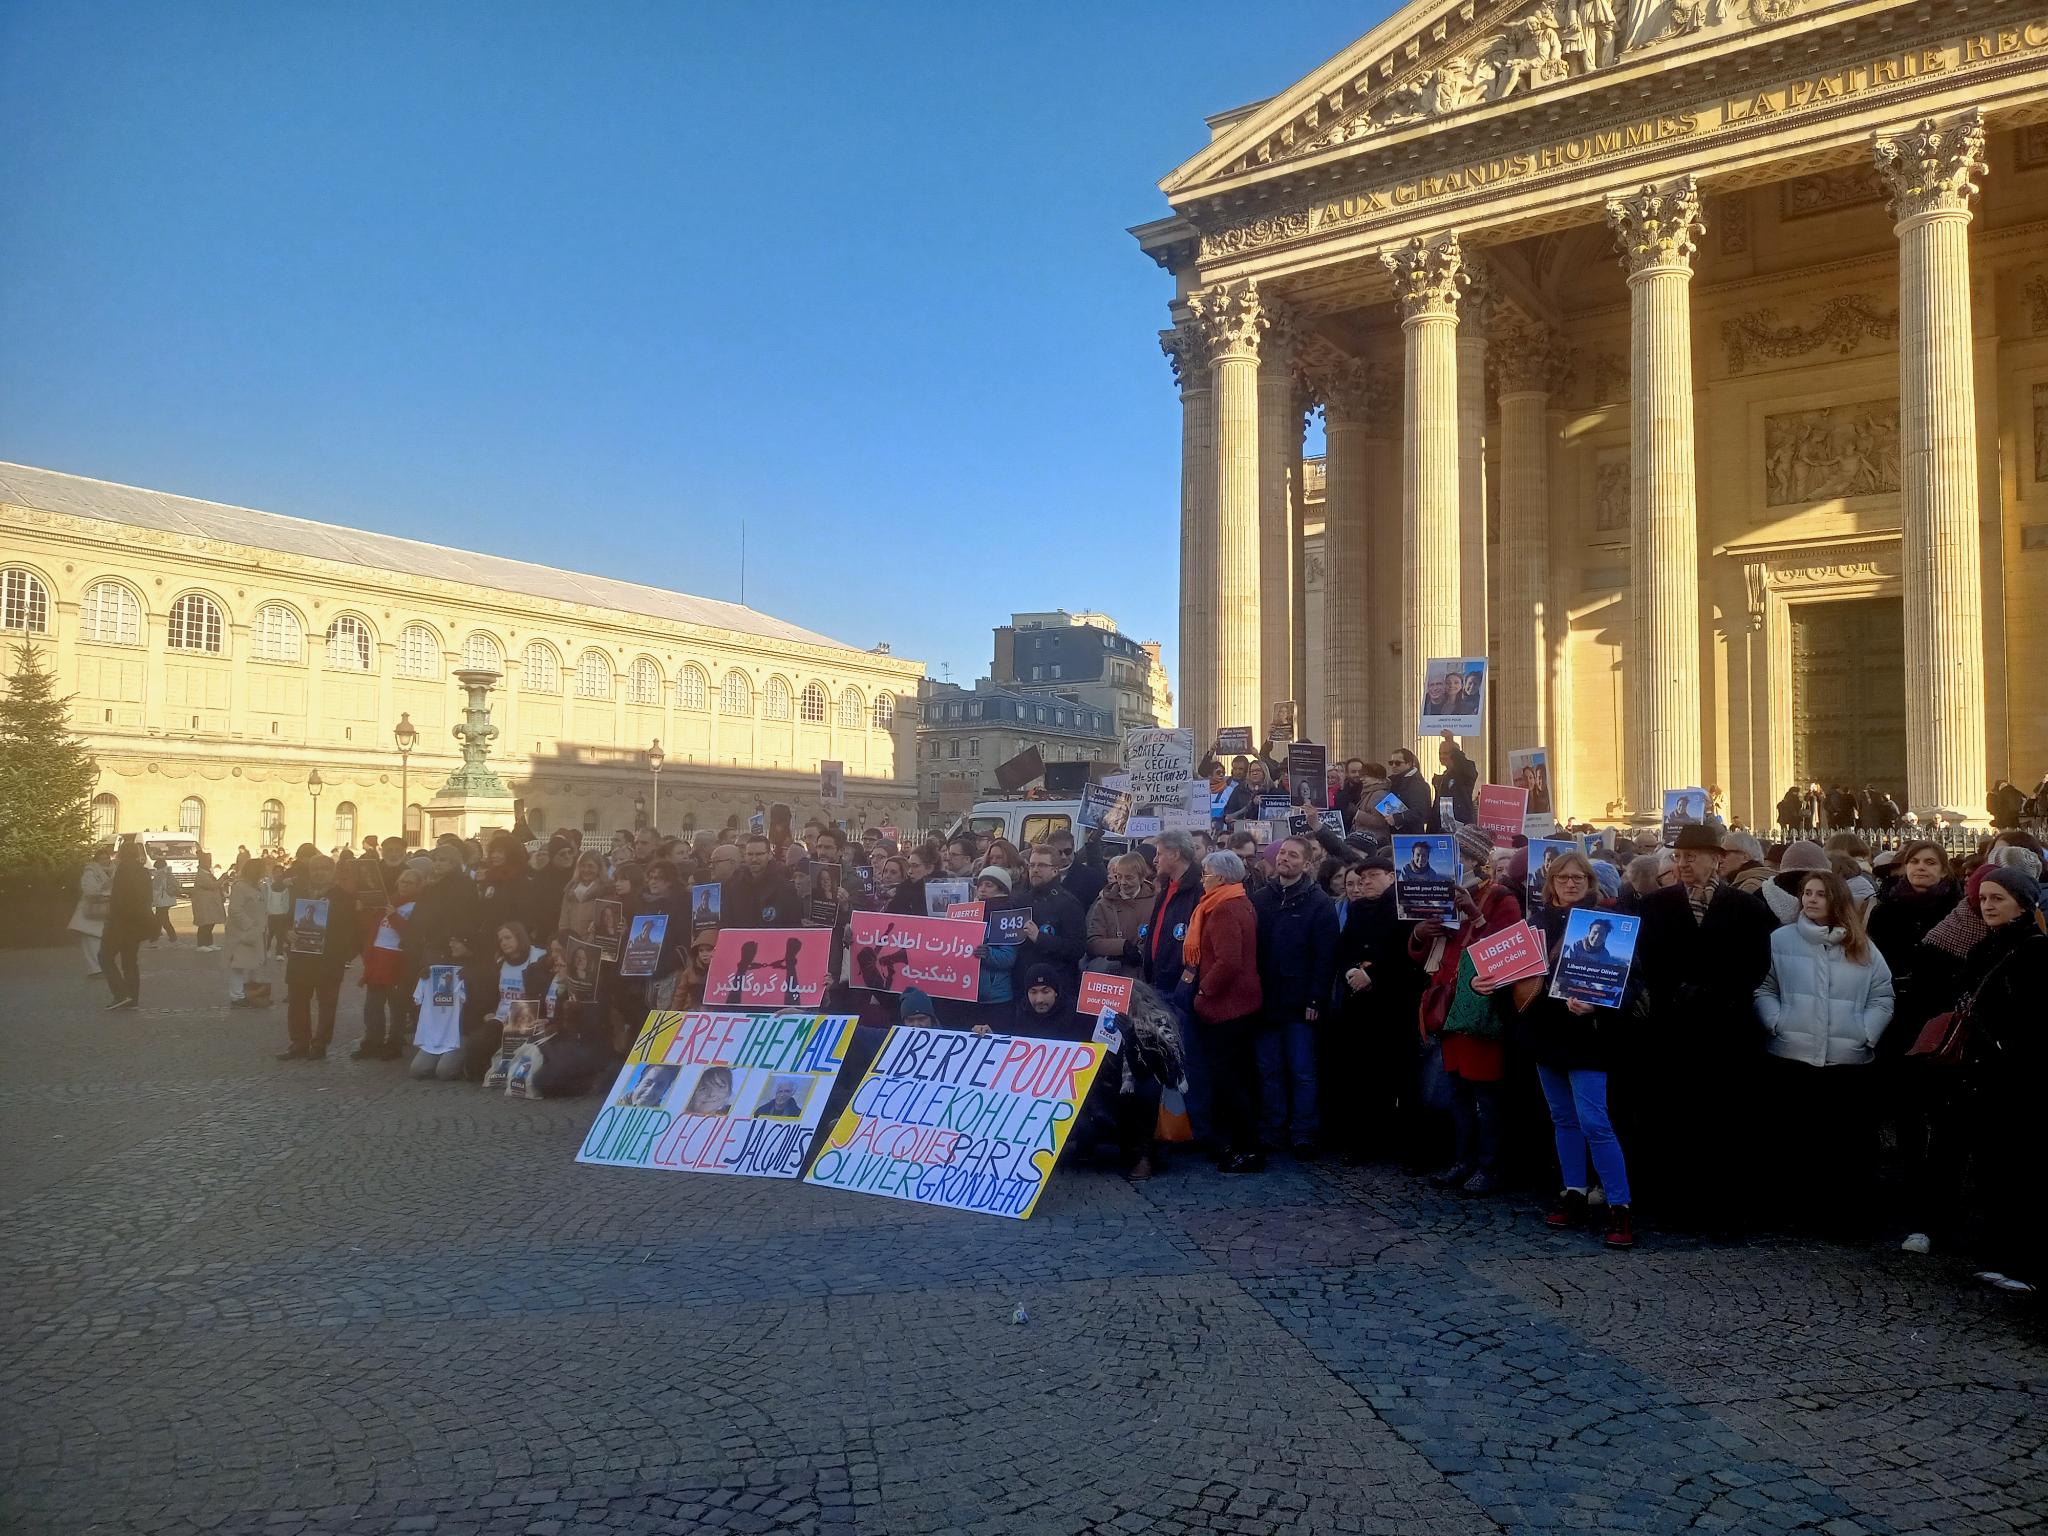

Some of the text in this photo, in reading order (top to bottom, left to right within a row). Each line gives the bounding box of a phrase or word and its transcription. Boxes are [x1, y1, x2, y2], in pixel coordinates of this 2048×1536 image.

[1320, 189, 1387, 225] AUX
[1394, 153, 1531, 204] GRANDS
[1538, 110, 1699, 168] HOMMES
[1724, 94, 1777, 124] LA
[1788, 47, 1947, 106] PATRIE
[1142, 733, 1175, 743] URGENT
[1132, 743, 1165, 758] SORTEZ
[1144, 757, 1179, 770] CÉCILE
[1144, 781, 1161, 792] VIE
[1165, 783, 1179, 792] est
[1149, 794, 1180, 803] DANGER
[950, 907, 980, 919] LIBERTÉ
[999, 915, 1024, 931] 843
[855, 928, 976, 960] وزارت اطلاعات
[1479, 930, 1525, 961] LIBERTÉ
[1487, 948, 1527, 973] pour Cécile
[901, 964, 972, 989] و شکنجه
[1087, 981, 1125, 996] LIBERTÉ
[780, 978, 818, 1002] سپاه
[1086, 996, 1121, 1008] pour Olivier
[871, 1025, 1096, 1100] LIBERTÉ POUR
[851, 1076, 1075, 1152] CÉCILE KOHLER
[584, 1106, 672, 1165] OLIVIER
[724, 1119, 814, 1175] JACQUES
[831, 1114, 1055, 1184] JACQUES PARIS
[812, 1150, 1041, 1215] OLIVIER GRONDEAU
